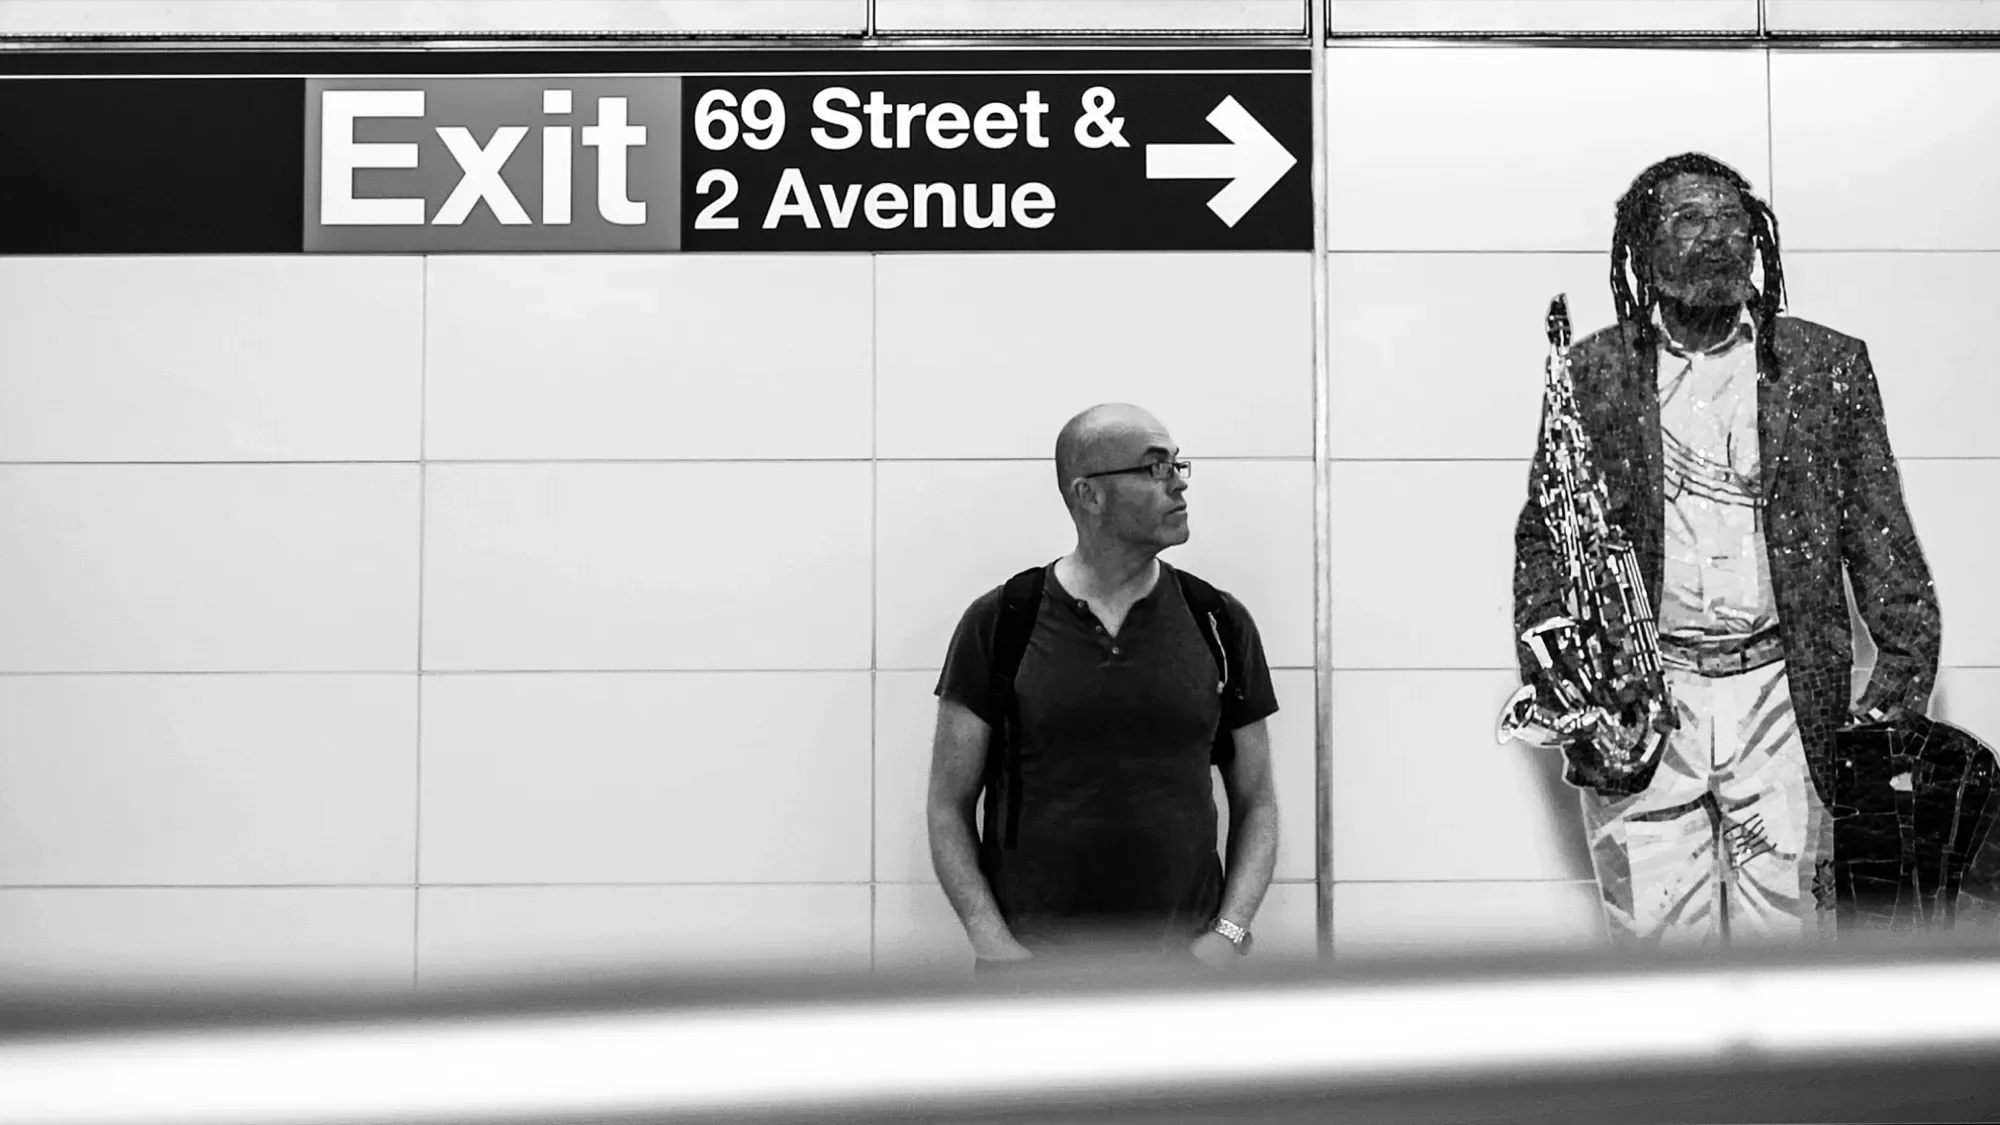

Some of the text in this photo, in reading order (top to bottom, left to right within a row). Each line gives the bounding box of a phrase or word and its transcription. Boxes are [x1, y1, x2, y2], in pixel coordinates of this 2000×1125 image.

[694, 86, 1130, 151] 69 Street &
[320, 89, 647, 226] Exit
[694, 168, 1057, 230] 2 Avenue
